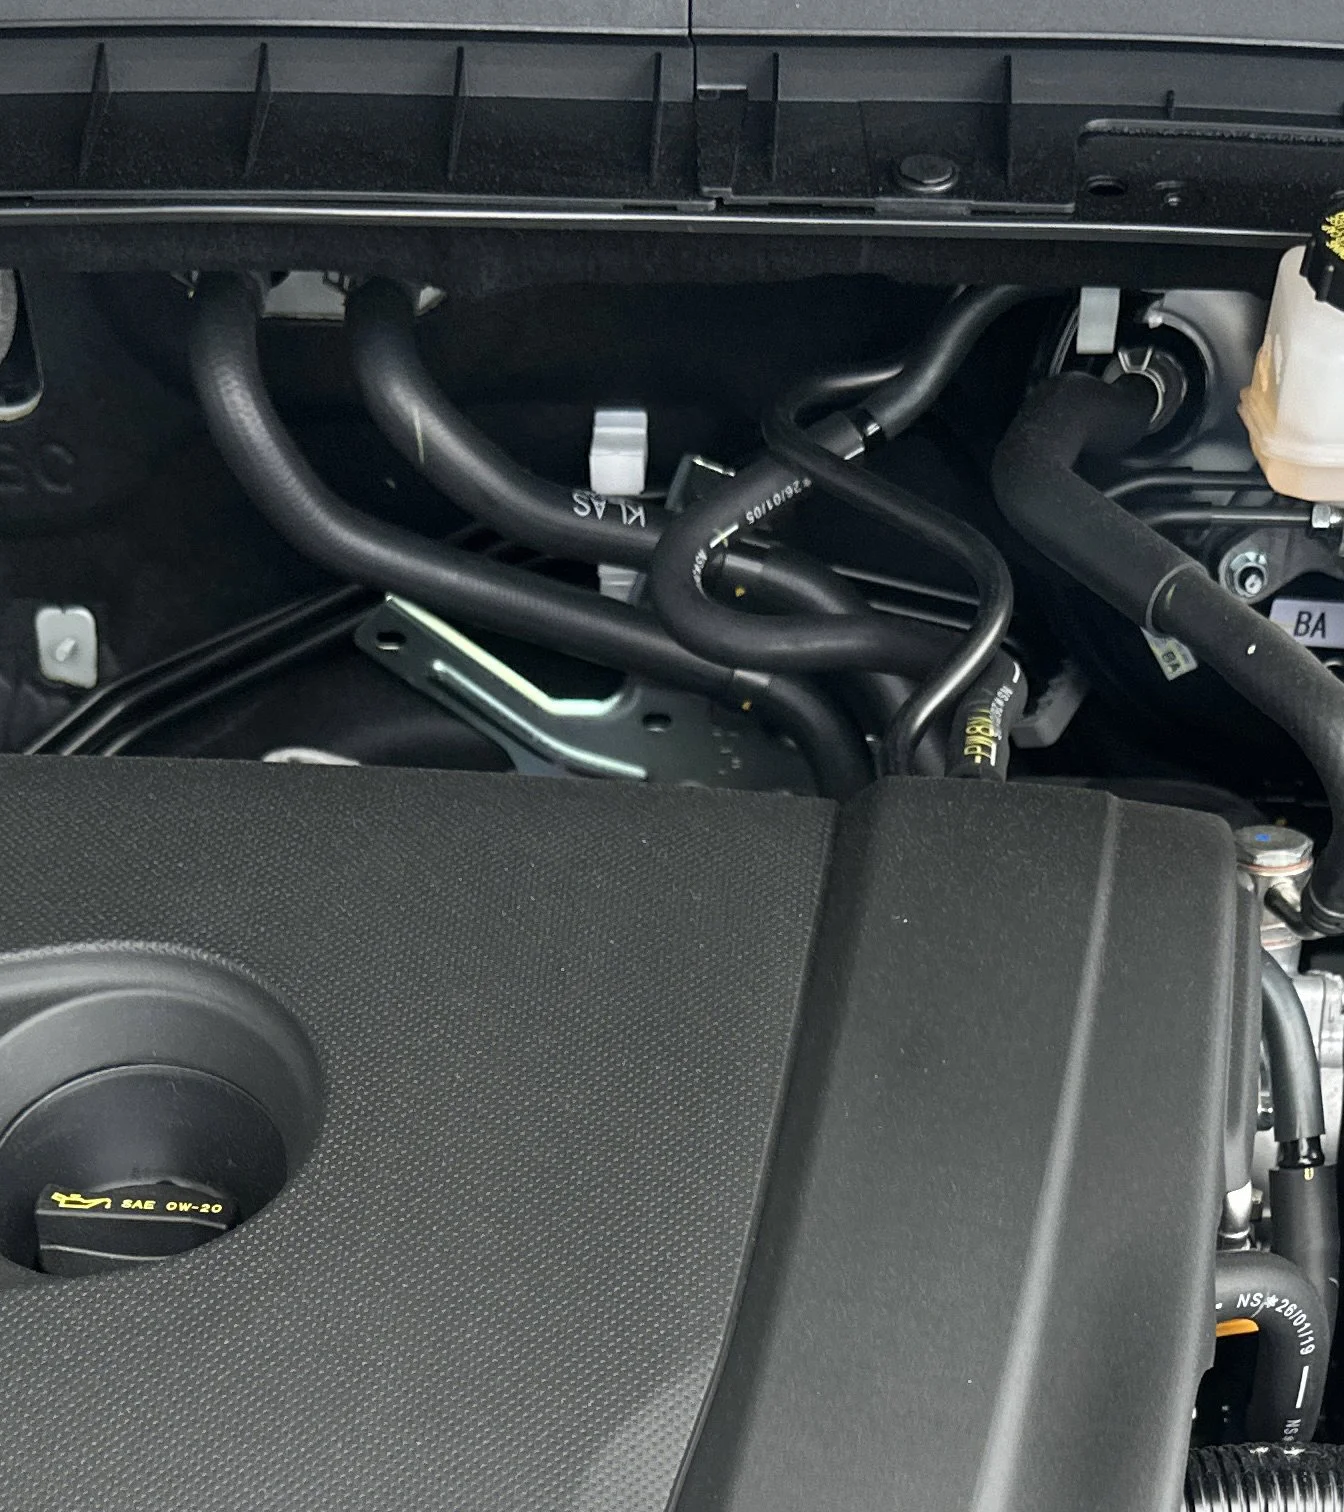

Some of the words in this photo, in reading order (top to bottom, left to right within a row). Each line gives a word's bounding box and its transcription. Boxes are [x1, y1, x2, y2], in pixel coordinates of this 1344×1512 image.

[1293, 611, 1328, 639] BA
[121, 1199, 156, 1209] SAE
[165, 1201, 223, 1213] 0W-20
